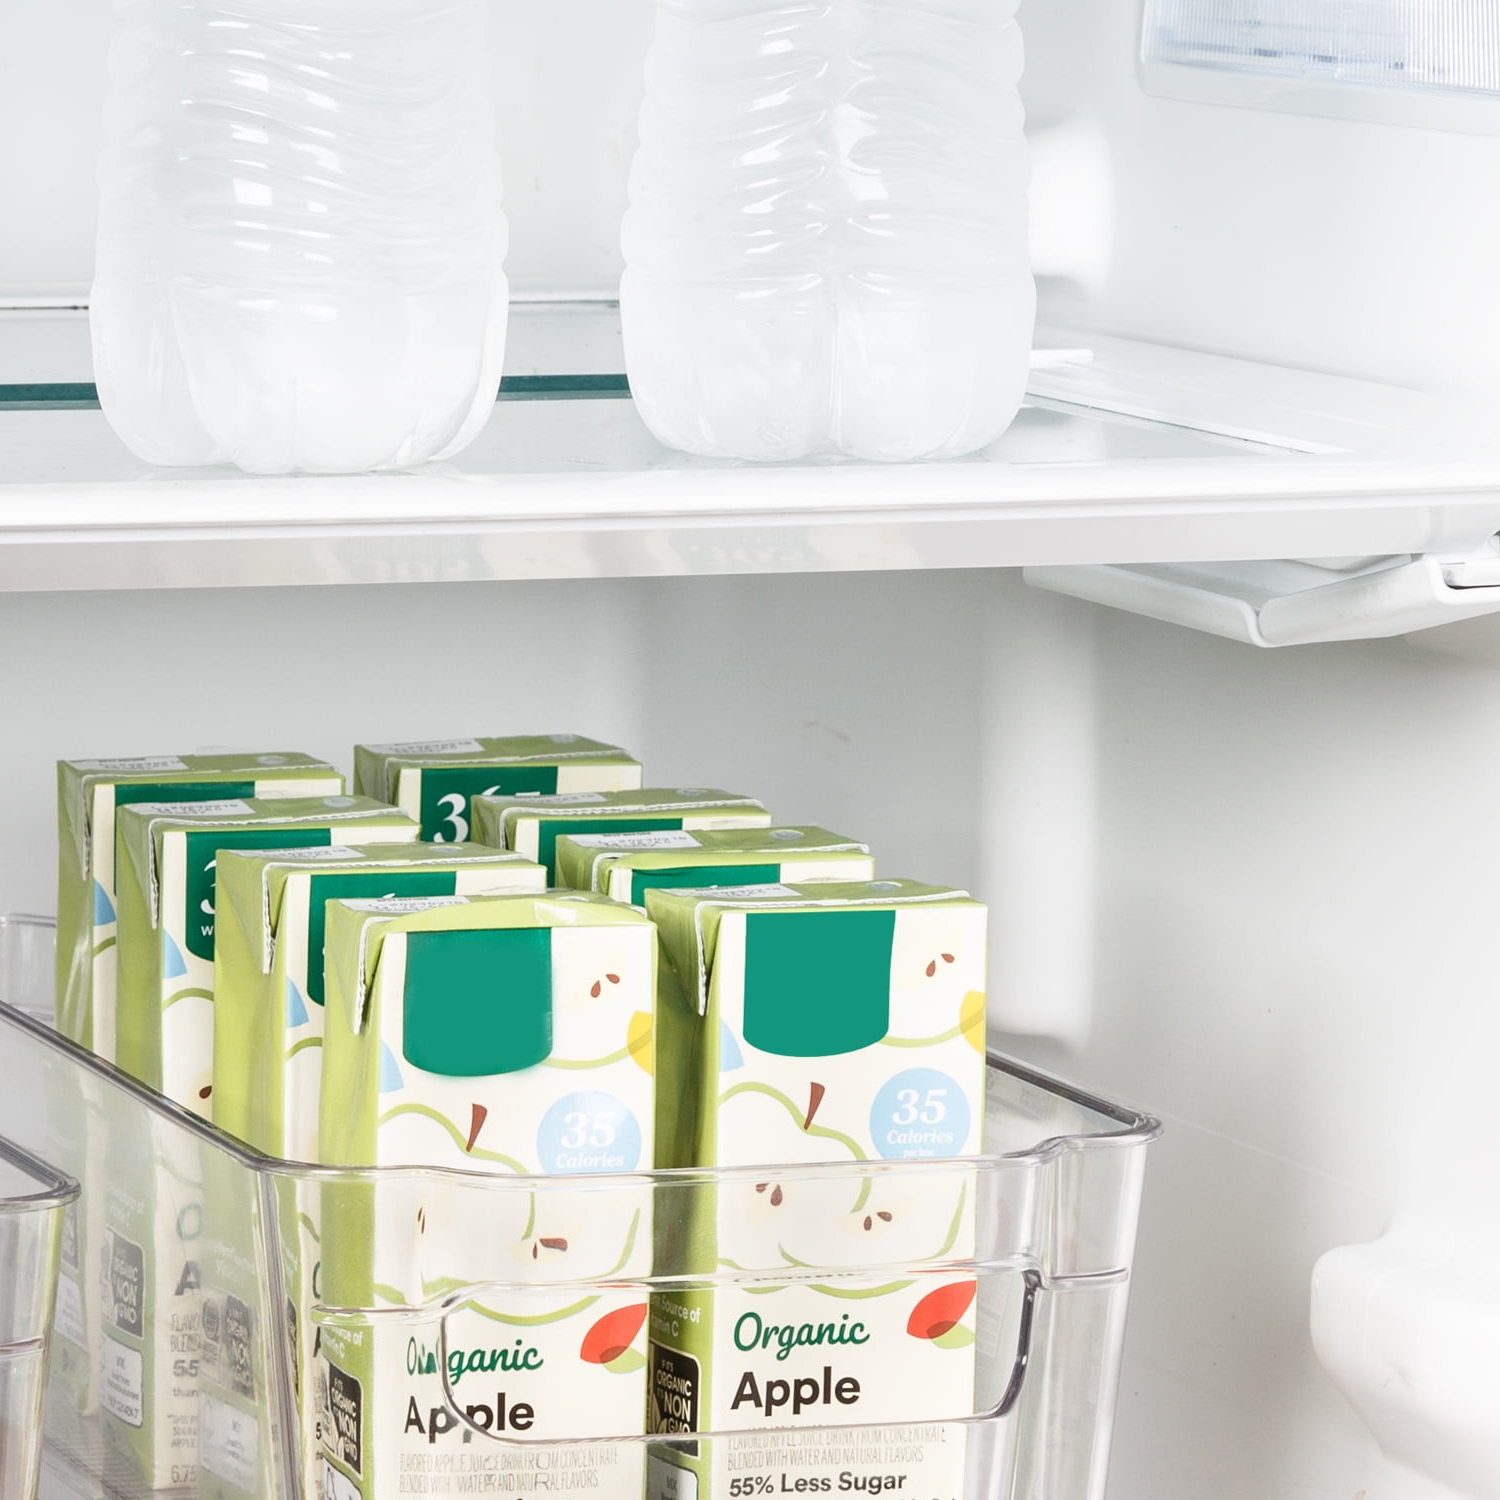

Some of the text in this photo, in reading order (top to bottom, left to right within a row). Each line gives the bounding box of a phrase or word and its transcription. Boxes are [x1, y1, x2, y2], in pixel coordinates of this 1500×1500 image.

[892, 1088, 948, 1125] 35
[561, 1111, 617, 1149] 35
[886, 1128, 954, 1145] Calories
[555, 1151, 624, 1170] Calories
[690, 1306, 701, 1323] of
[733, 1311, 870, 1361] Organic
[656, 1369, 692, 1396] ORGANIC
[730, 1366, 861, 1417] Apple
[404, 1392, 535, 1444] Apple
[664, 1391, 691, 1422] NON
[727, 1445, 924, 1472] BLENDED WITH WATER AND NATURAL FLAVORS
[729, 1471, 907, 1498] 55% Less Sugar
